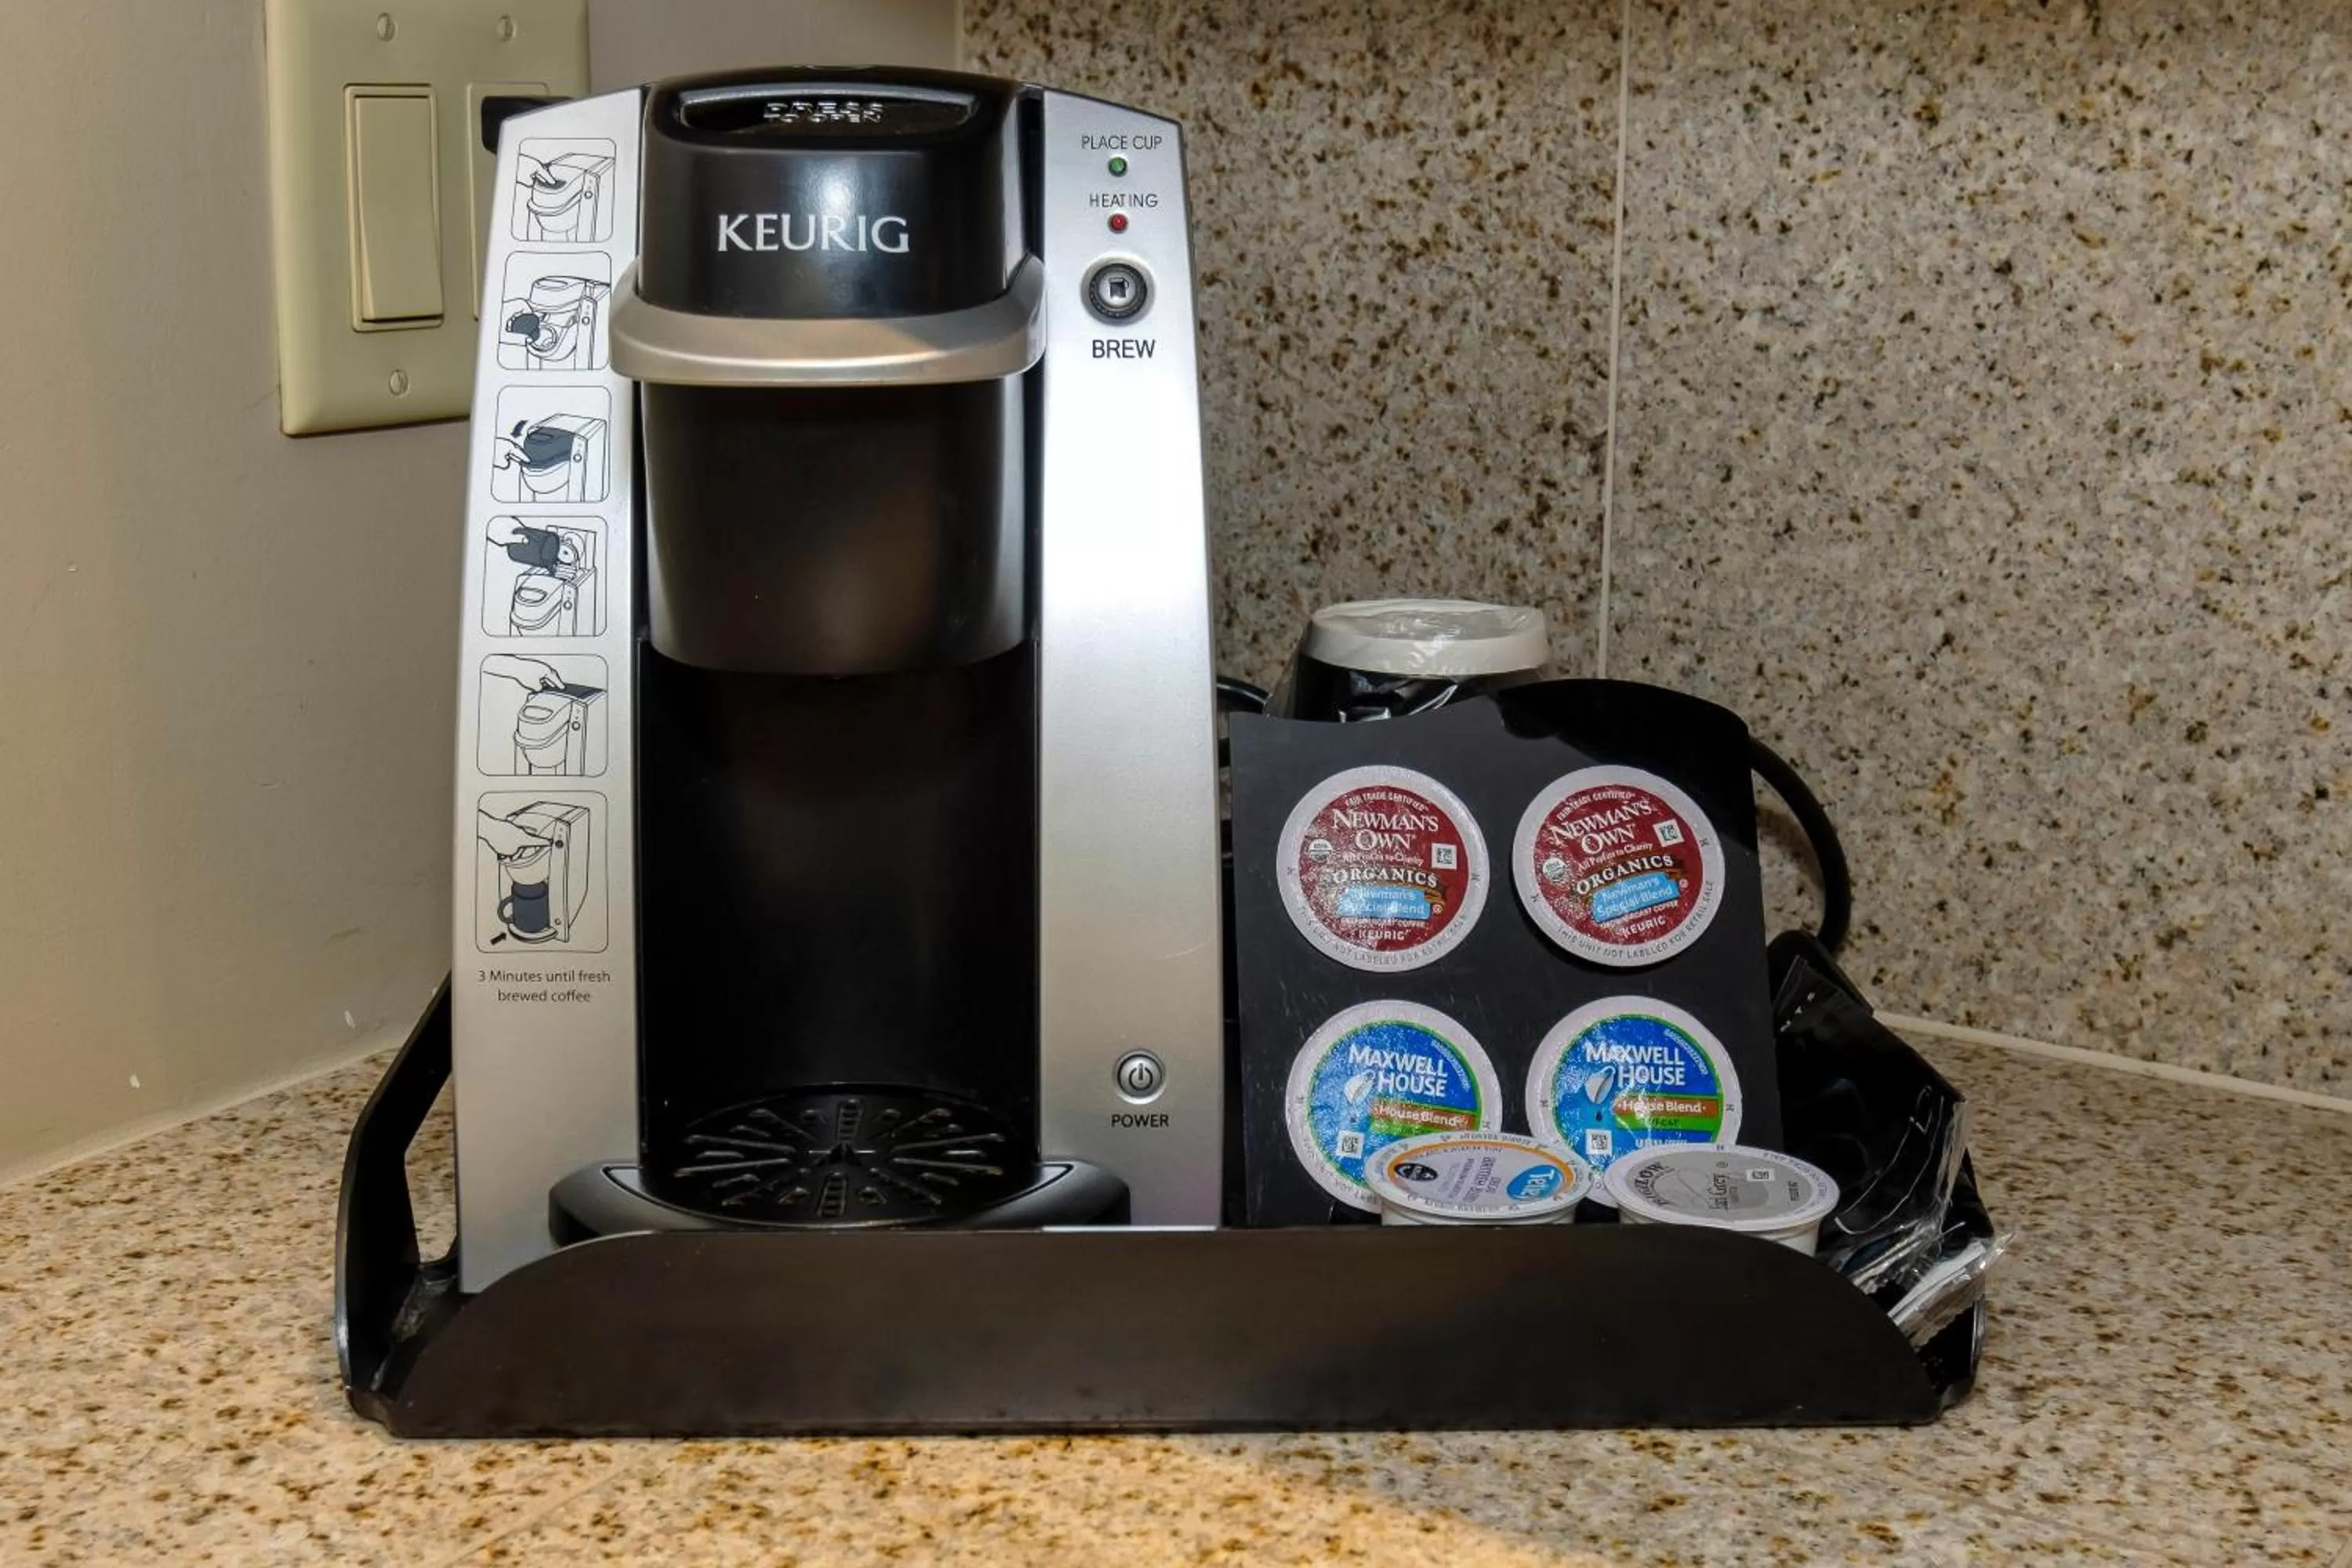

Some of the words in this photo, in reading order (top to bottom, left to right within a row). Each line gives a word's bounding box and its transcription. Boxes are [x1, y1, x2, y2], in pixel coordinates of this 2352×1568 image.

[765, 102, 884, 114] PRESS
[1081, 135, 1127, 150] PLACE
[1133, 135, 1163, 150] CUP
[1089, 194, 1158, 208] HEATING
[717, 214, 909, 253] KEURIG
[1092, 339, 1155, 358] BREW
[1332, 808, 1439, 833] NEWMAN'S
[1549, 799, 1652, 846] NEWMAN'S
[1356, 829, 1411, 851] OWN
[1581, 822, 1635, 855] OWN
[1331, 866, 1439, 888] ORGANICS
[1576, 855, 1674, 895] ORGANICS
[1602, 948, 1623, 958] NOT
[477, 970, 485, 982] 3
[489, 970, 543, 982] Minutes
[546, 970, 575, 982] until
[579, 969, 611, 982] fresh
[498, 989, 547, 1002] brewed
[551, 989, 591, 1003] coffee
[1348, 1044, 1448, 1078] MAXWELL
[1586, 1041, 1686, 1065] MAXWELL
[1377, 1072, 1446, 1098] HOUSE
[1618, 1065, 1686, 1088] HOUSE
[1665, 1102, 1703, 1113] Blend
[1111, 1114, 1170, 1127] POWER
